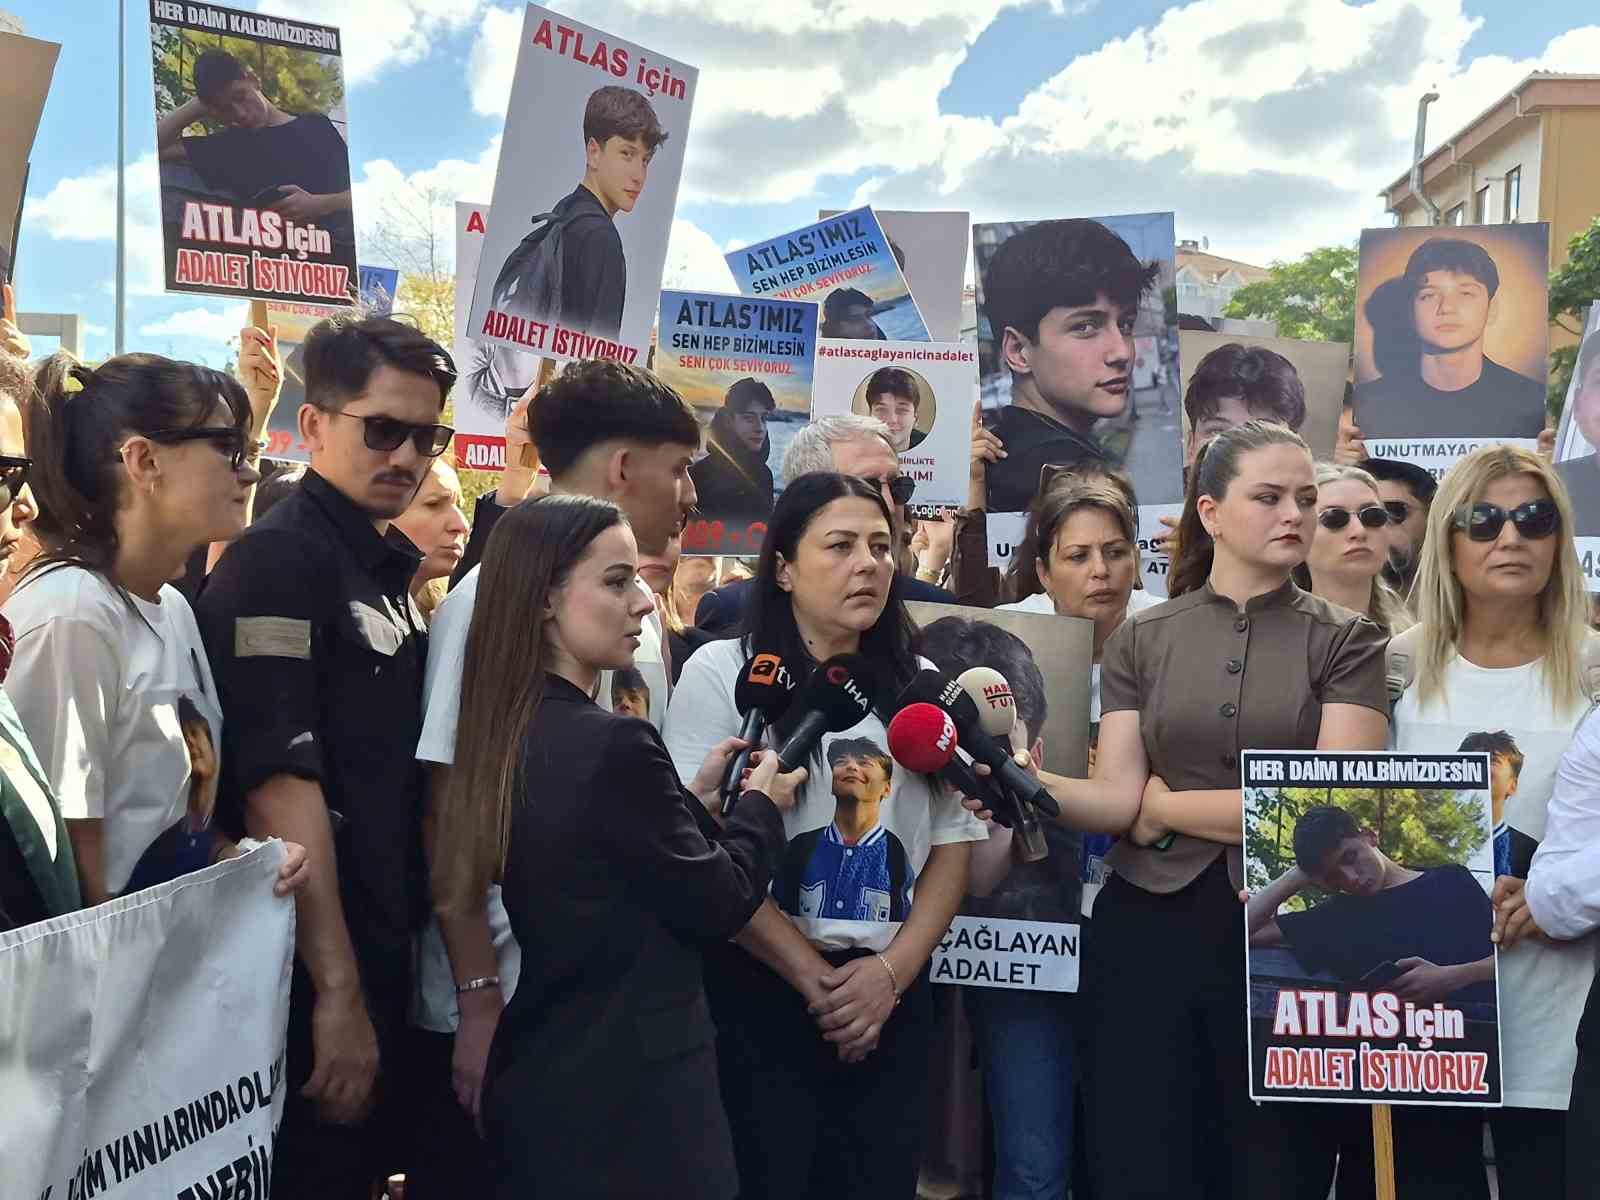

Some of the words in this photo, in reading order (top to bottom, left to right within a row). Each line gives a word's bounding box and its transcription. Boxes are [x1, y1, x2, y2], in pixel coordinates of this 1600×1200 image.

[154, 1, 183, 22] HER
[187, 8, 227, 30] DAİM
[229, 14, 337, 50] KALBİMİZDESİN
[532, 19, 628, 77] ATLAS
[636, 58, 686, 100] için
[182, 202, 282, 249] ATLAS
[286, 221, 331, 259] için
[746, 215, 867, 275] ATLAS'IMIZ
[176, 248, 249, 289] ADALET
[251, 250, 350, 298] İSTİYORUZ
[752, 273, 780, 294] SEN
[780, 264, 806, 285] HEP
[806, 240, 878, 276] BİZİMLESİN
[482, 310, 549, 349] ADALET
[676, 299, 806, 334] ATLAS'IMIZ
[672, 333, 700, 349] SEN
[703, 335, 731, 351] HEP
[734, 333, 805, 357] BİZİMLESİN
[679, 353, 705, 369] SENİ
[708, 357, 730, 373] ÇOK
[818, 345, 975, 363] #atlascaglayanicinadalet
[752, 659, 796, 690] atv
[1250, 760, 1284, 780] HER
[1289, 757, 1337, 781] DAİM
[1342, 757, 1482, 783] KALBİMİZDESİN
[936, 958, 1042, 985] ADALET
[1273, 991, 1400, 1037] ATLAS
[1404, 1003, 1464, 1049] için
[1264, 1047, 1356, 1089] ADALET
[1358, 1041, 1489, 1094] İSTİYORUZ
